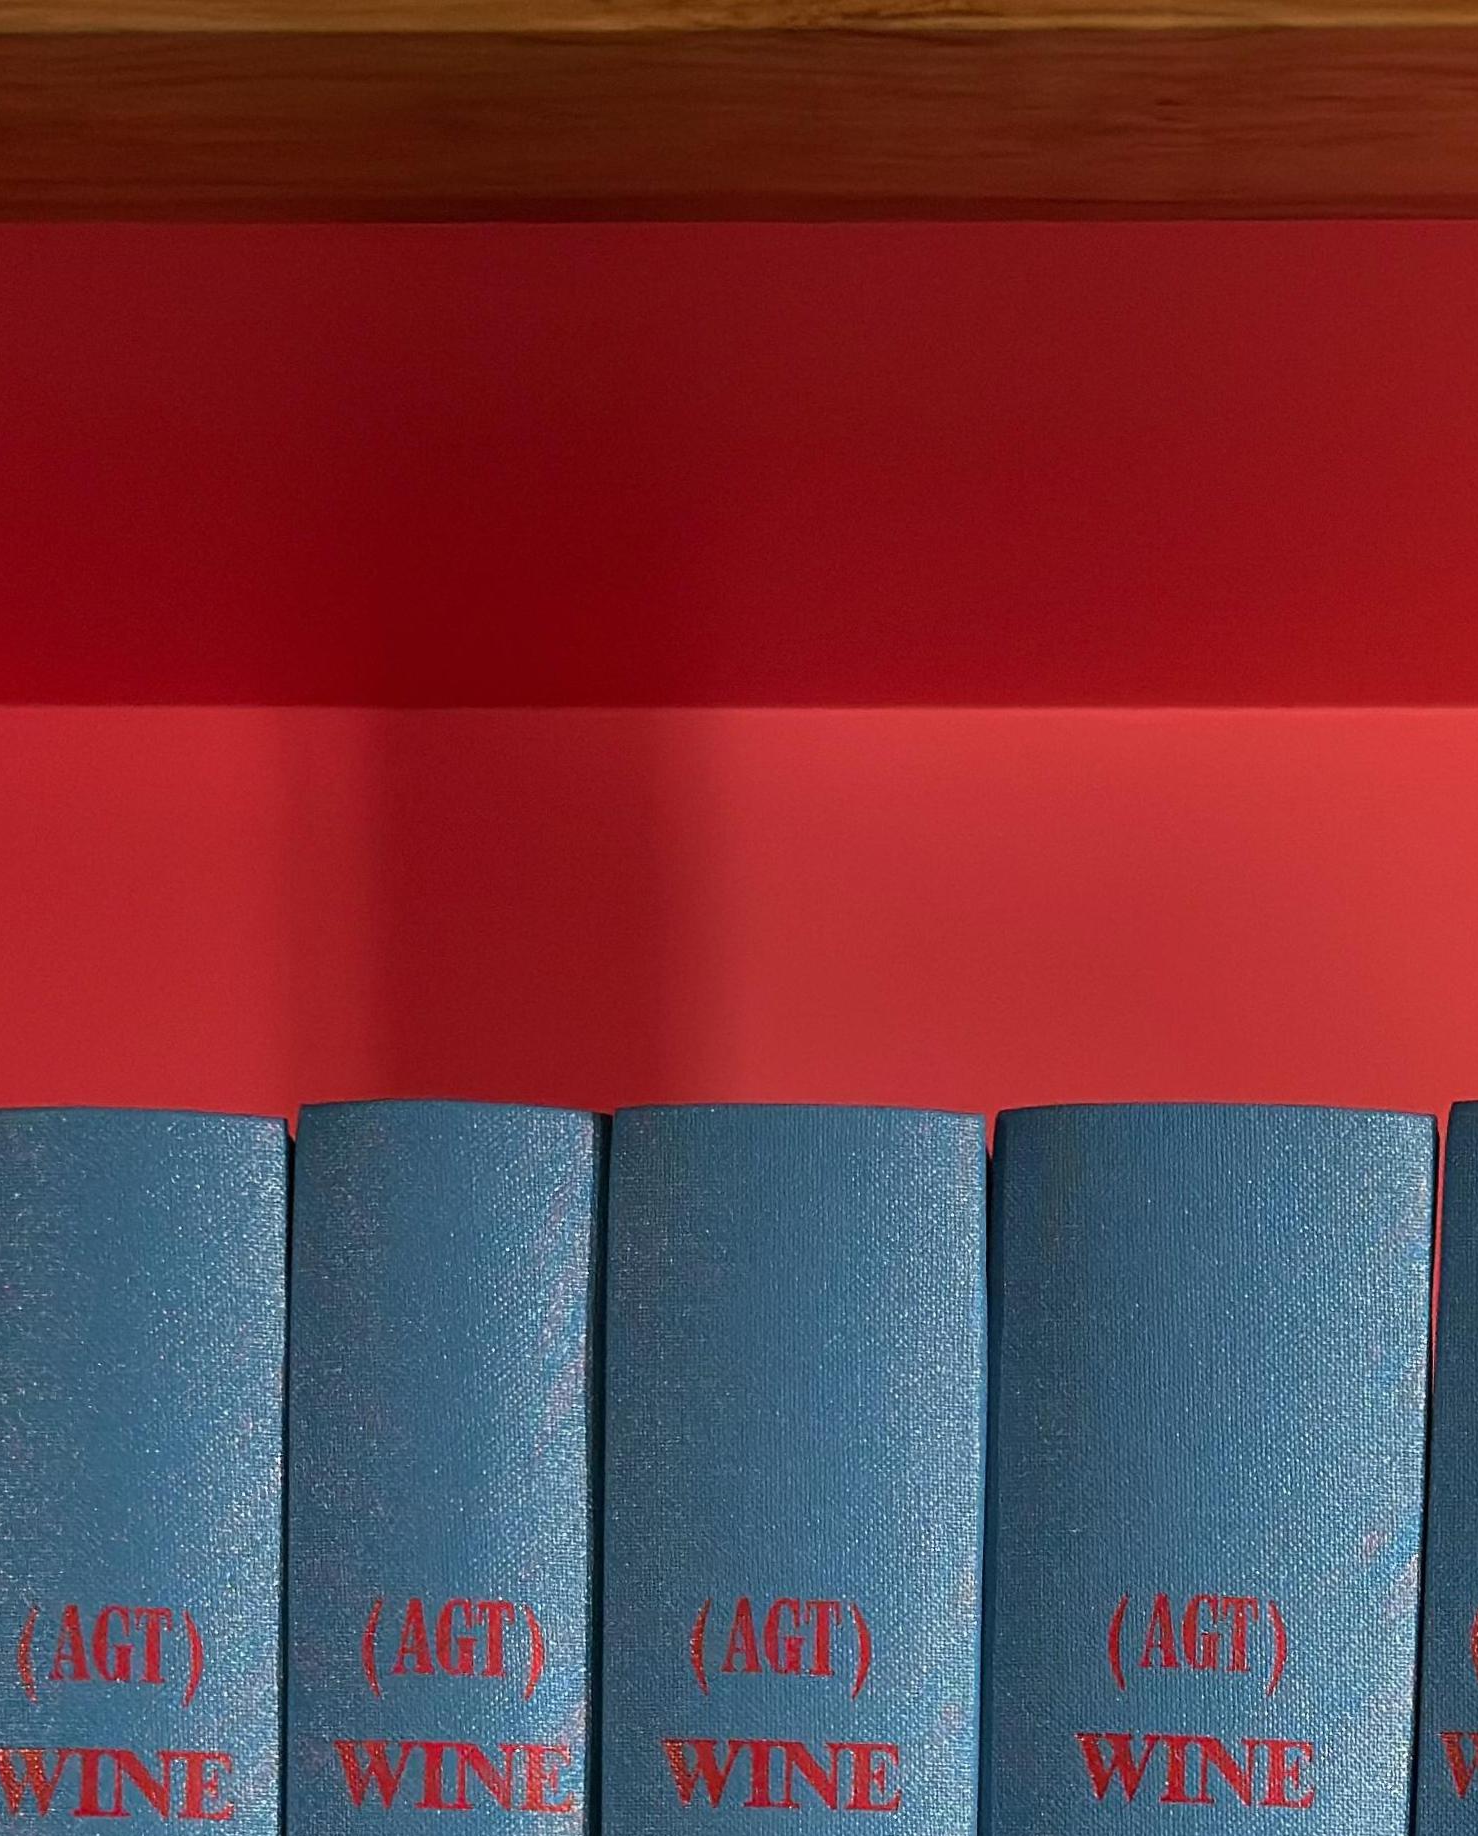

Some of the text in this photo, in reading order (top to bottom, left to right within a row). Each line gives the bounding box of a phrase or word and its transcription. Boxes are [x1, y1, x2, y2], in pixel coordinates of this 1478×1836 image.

[19, 1605, 204, 1706] (AGT)
[362, 1597, 545, 1701] (AGT)
[691, 1597, 873, 1698] (AGT)
[1109, 1594, 1287, 1693] (AGT)
[333, 1739, 574, 1814] WINE
[663, 1739, 902, 1813] WINE
[1078, 1733, 1316, 1810] WINE
